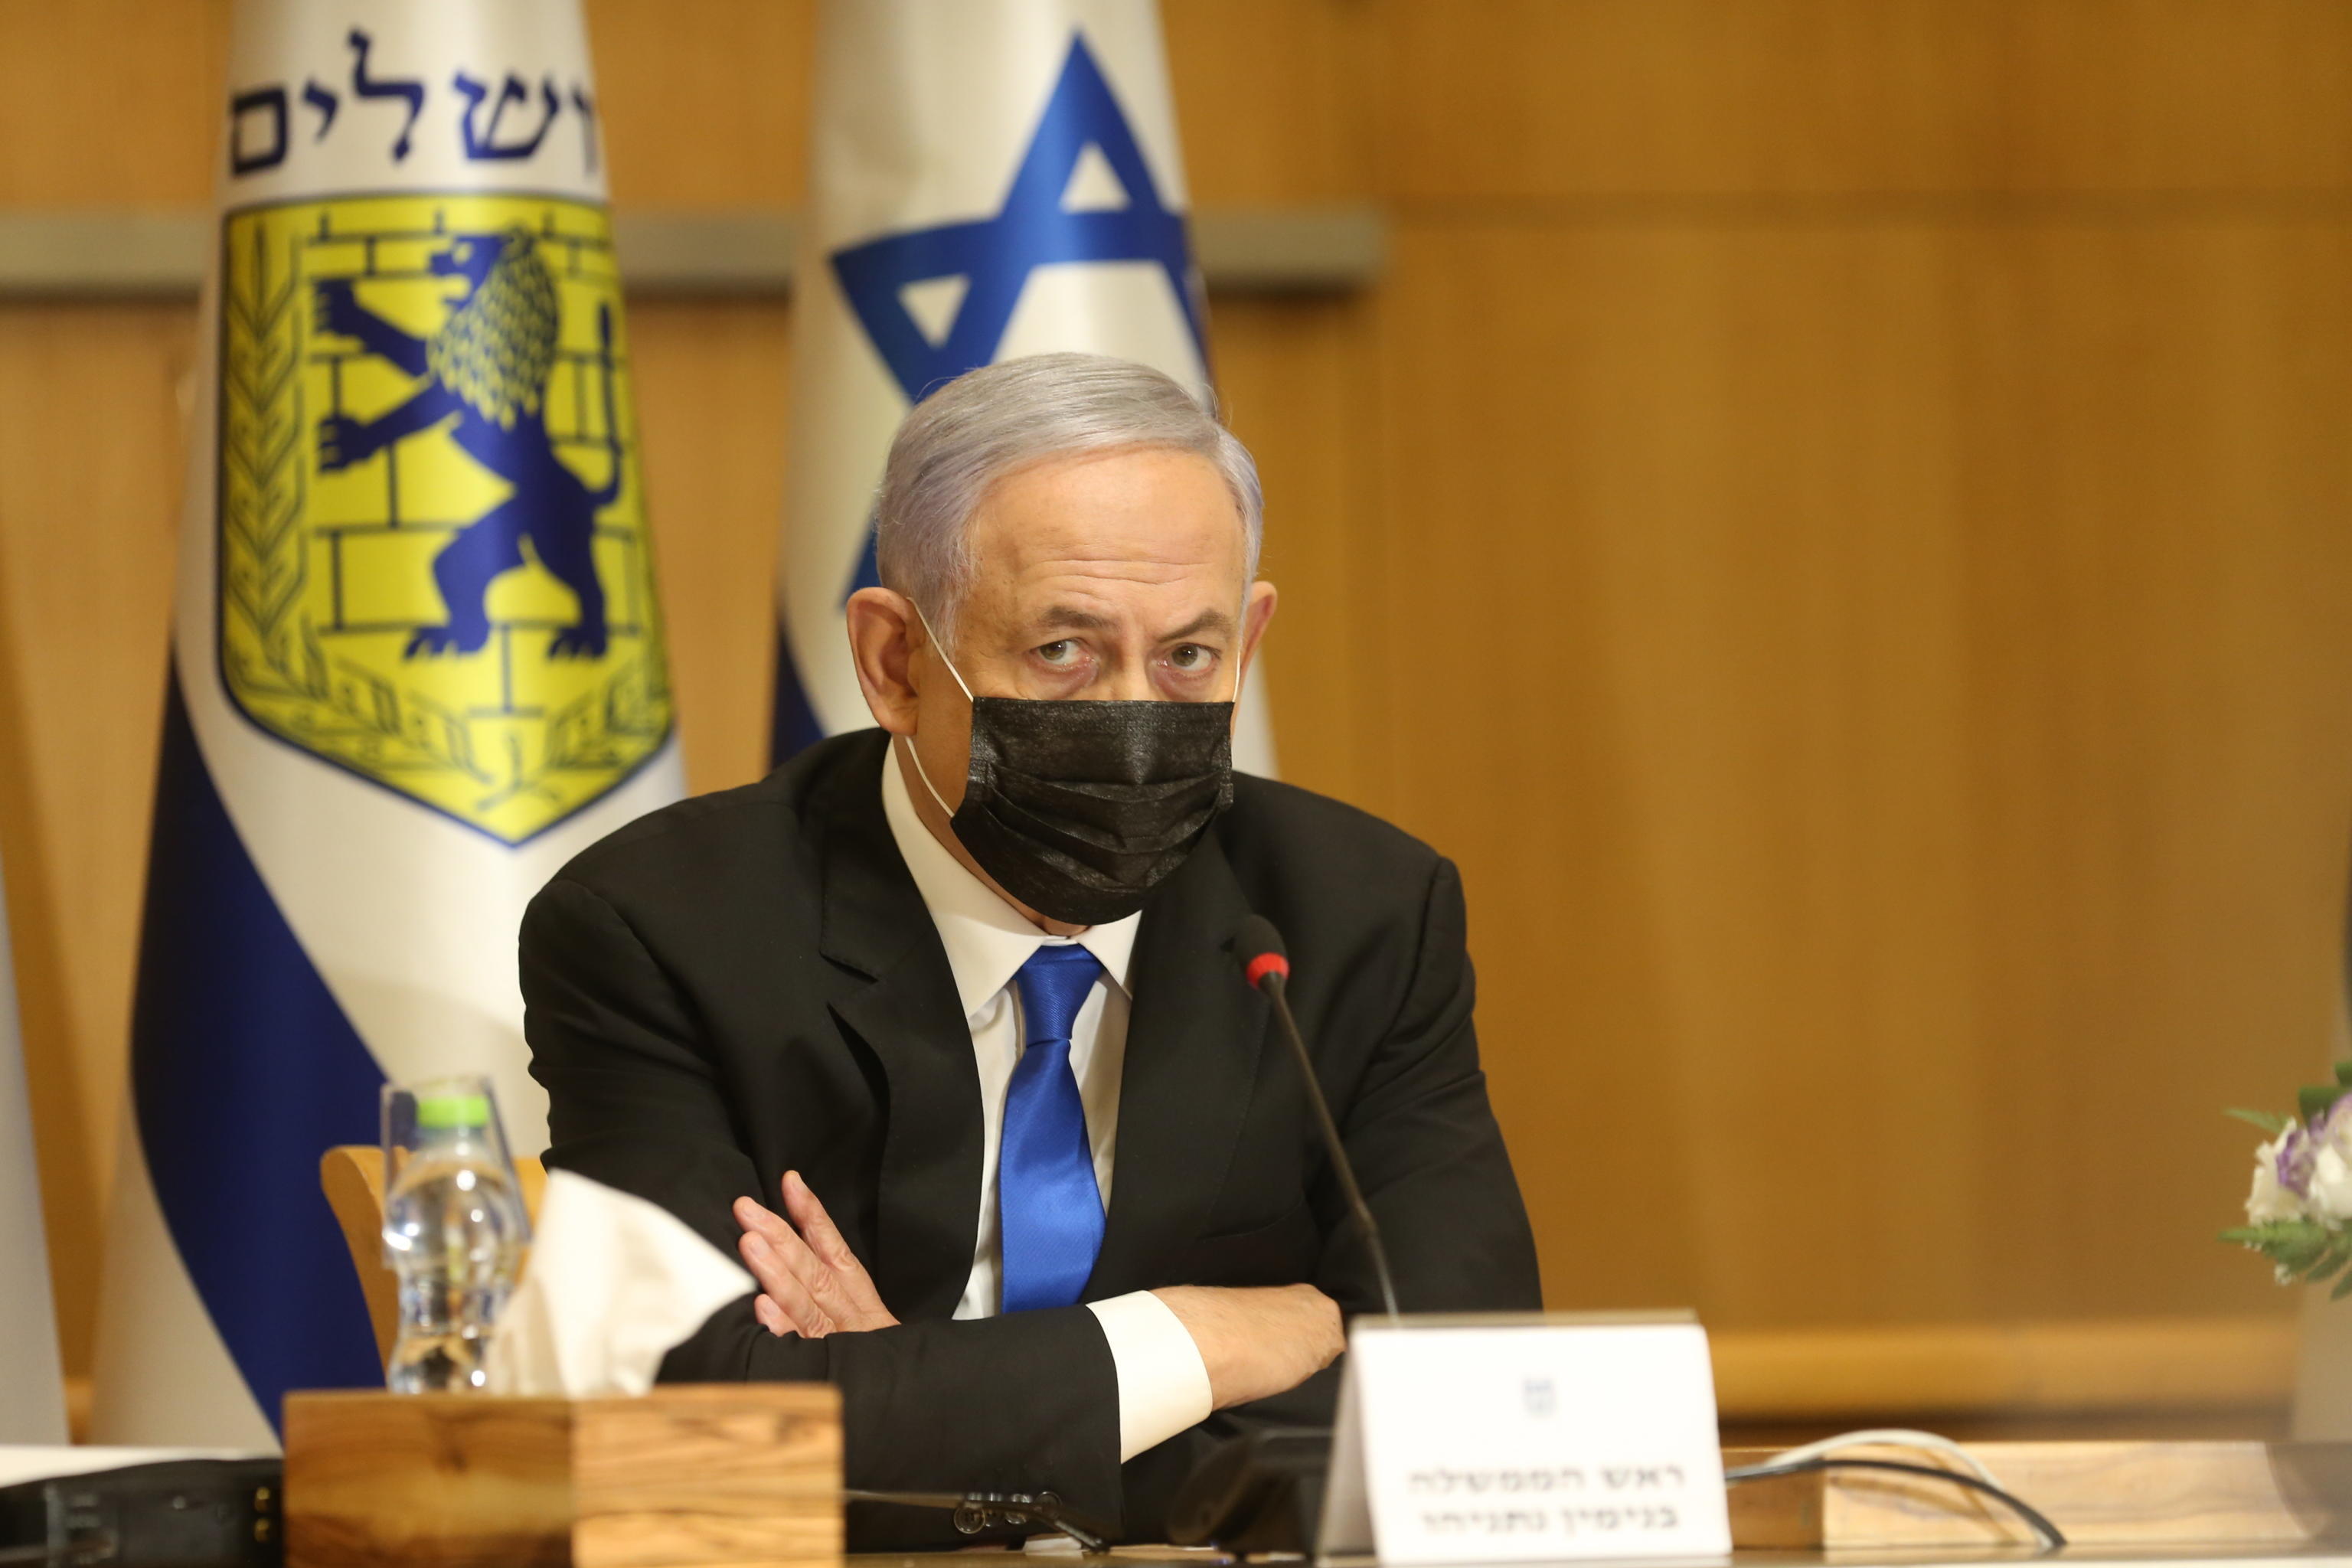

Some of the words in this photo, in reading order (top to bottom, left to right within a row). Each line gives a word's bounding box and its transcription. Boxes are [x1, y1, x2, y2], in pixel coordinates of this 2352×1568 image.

[1409, 1466, 1586, 1494] הממשלה
[1599, 1463, 1685, 1491] ראש
[1560, 1504, 1680, 1536] בנימין
